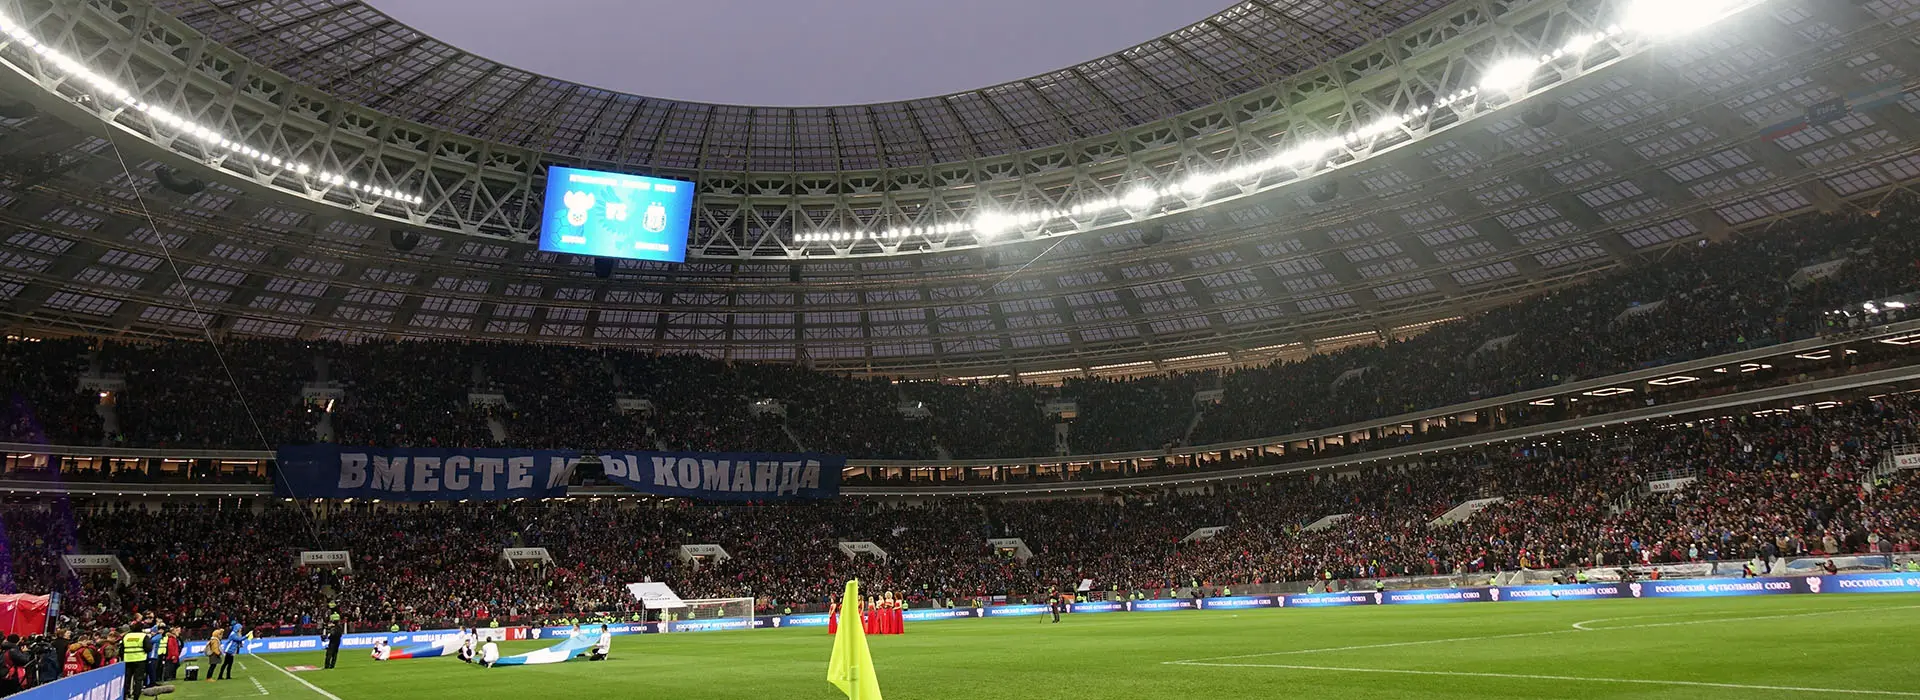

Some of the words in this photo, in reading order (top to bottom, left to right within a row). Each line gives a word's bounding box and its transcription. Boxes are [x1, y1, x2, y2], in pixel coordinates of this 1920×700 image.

[338, 453, 534, 491] ВМЕСТЕ
[652, 456, 820, 496] КОМАНДА
[1655, 584, 1706, 593] РОССИЙСКИЙ
[1707, 581, 1764, 592] ФУТБОЛЬНЫЙ
[1764, 581, 1791, 590] СОЮЗ
[1839, 578, 1904, 588] РОССИЙСКИЙ
[1510, 589, 1550, 597] РОССИЙСКИЙ
[1596, 587, 1618, 595] СОЮЗ
